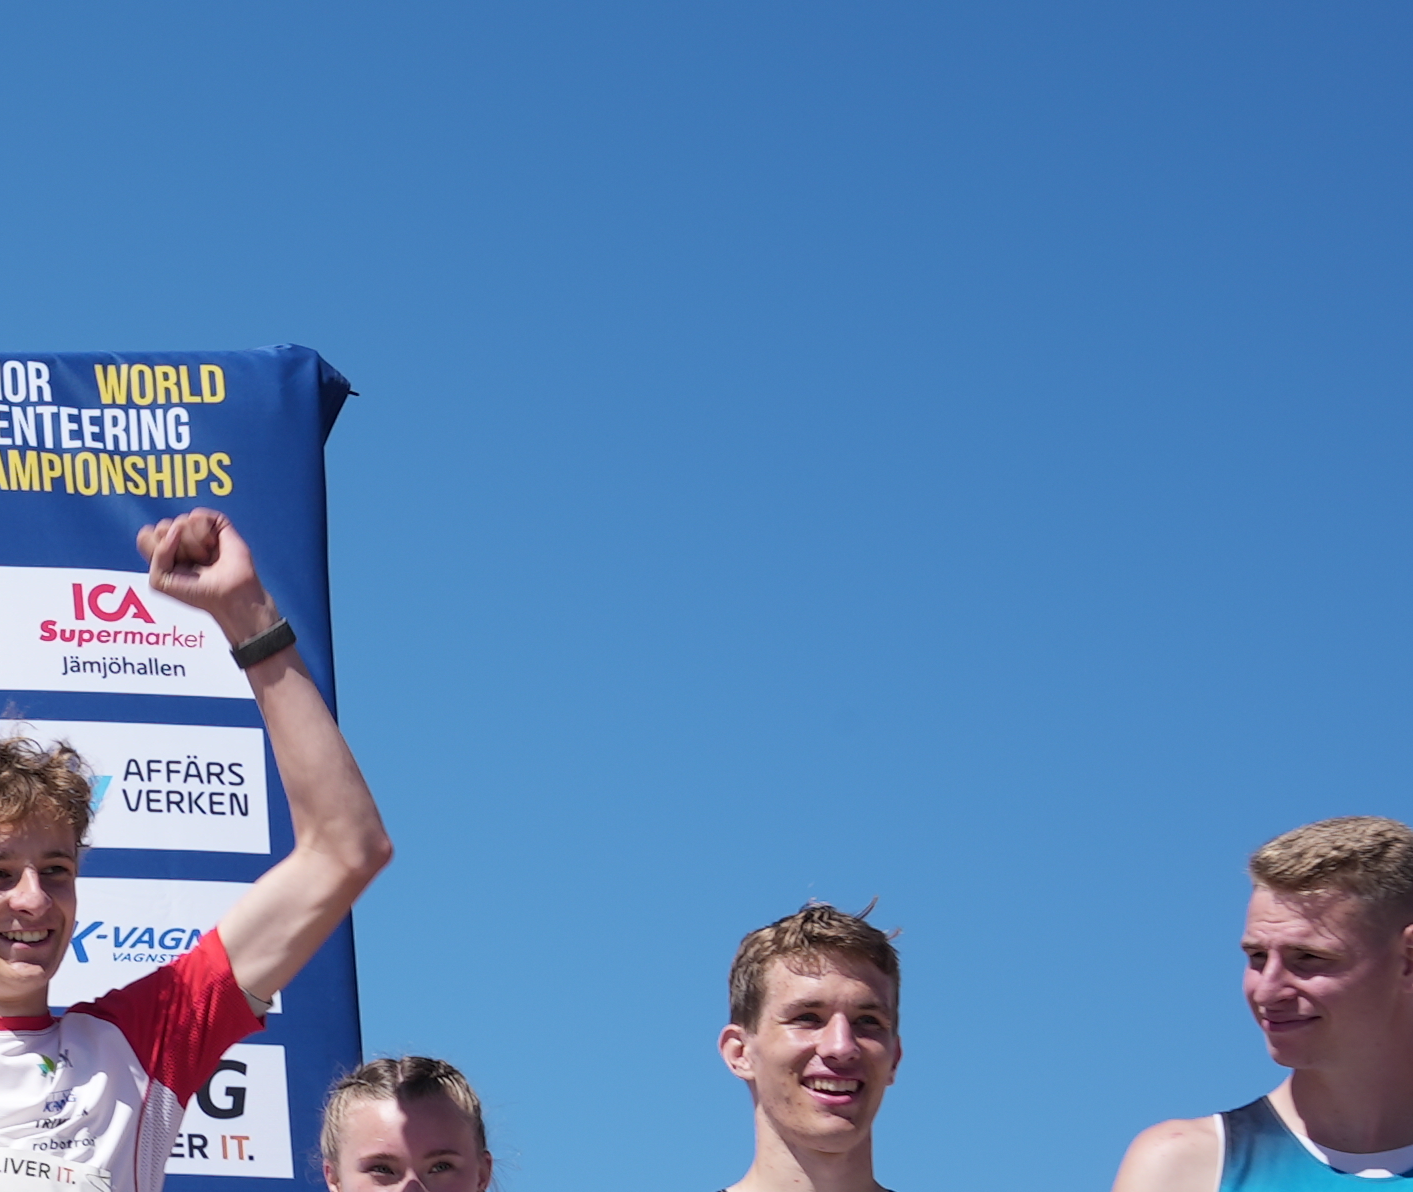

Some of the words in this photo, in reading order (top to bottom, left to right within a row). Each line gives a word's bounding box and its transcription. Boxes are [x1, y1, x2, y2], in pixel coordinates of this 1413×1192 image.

[94, 363, 226, 405] WORLD
[72, 582, 156, 624] ICA
[39, 620, 206, 649] Supermarket
[62, 654, 186, 680] Jämjöhallen
[123, 756, 246, 787] AFFÄRS
[122, 788, 249, 818] VERKEN
[220, 1134, 255, 1162] IT.
[57, 1166, 76, 1185] IT.
